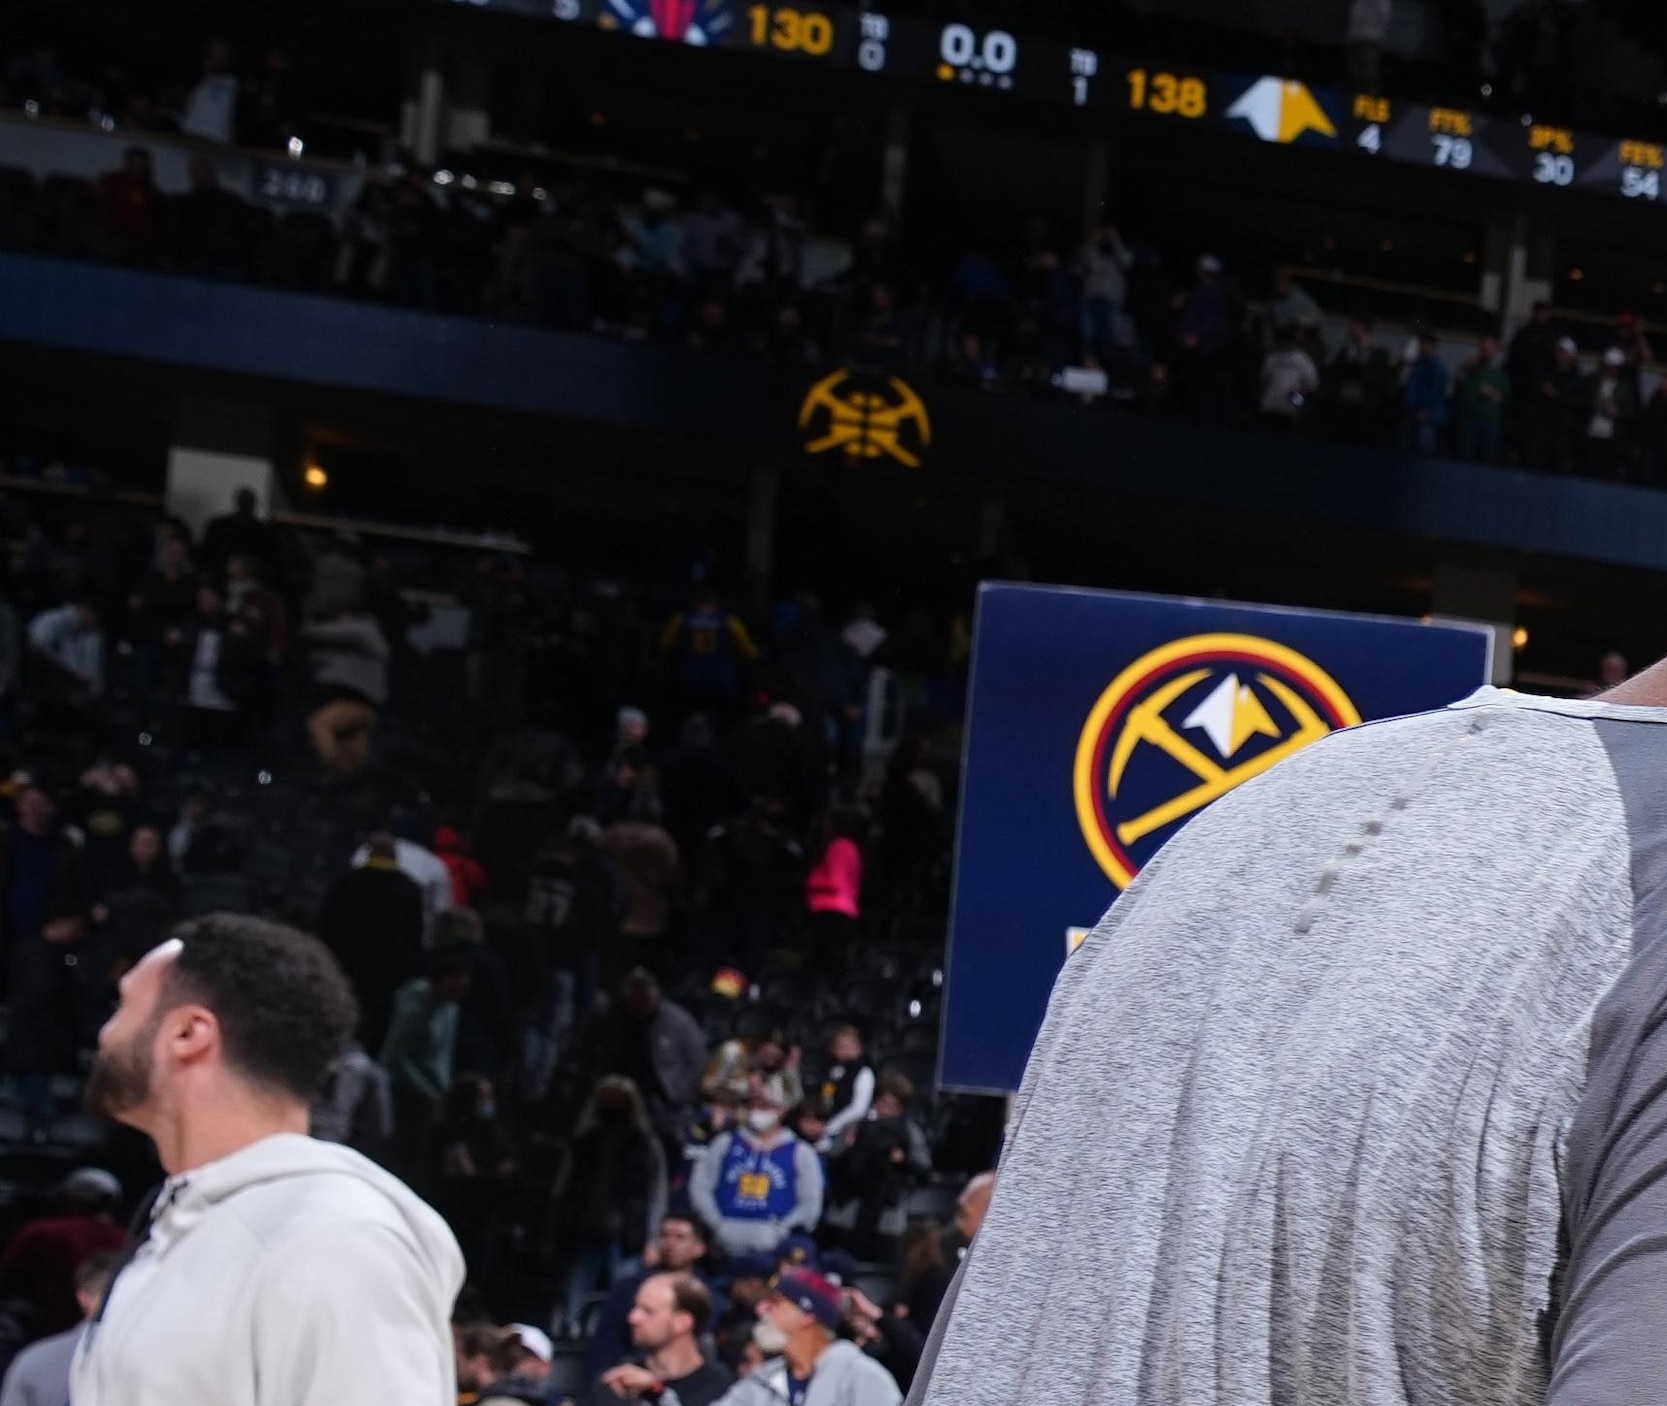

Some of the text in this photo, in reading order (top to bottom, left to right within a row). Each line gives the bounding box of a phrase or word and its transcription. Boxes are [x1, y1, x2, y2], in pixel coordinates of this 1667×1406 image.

[749, 5, 833, 55] 130
[940, 23, 1017, 73] 0.0
[1127, 68, 1206, 118] 138
[1357, 123, 1382, 154] 4
[1431, 133, 1473, 169] 79
[1533, 152, 1575, 186] 30
[1621, 166, 1659, 200] 54
